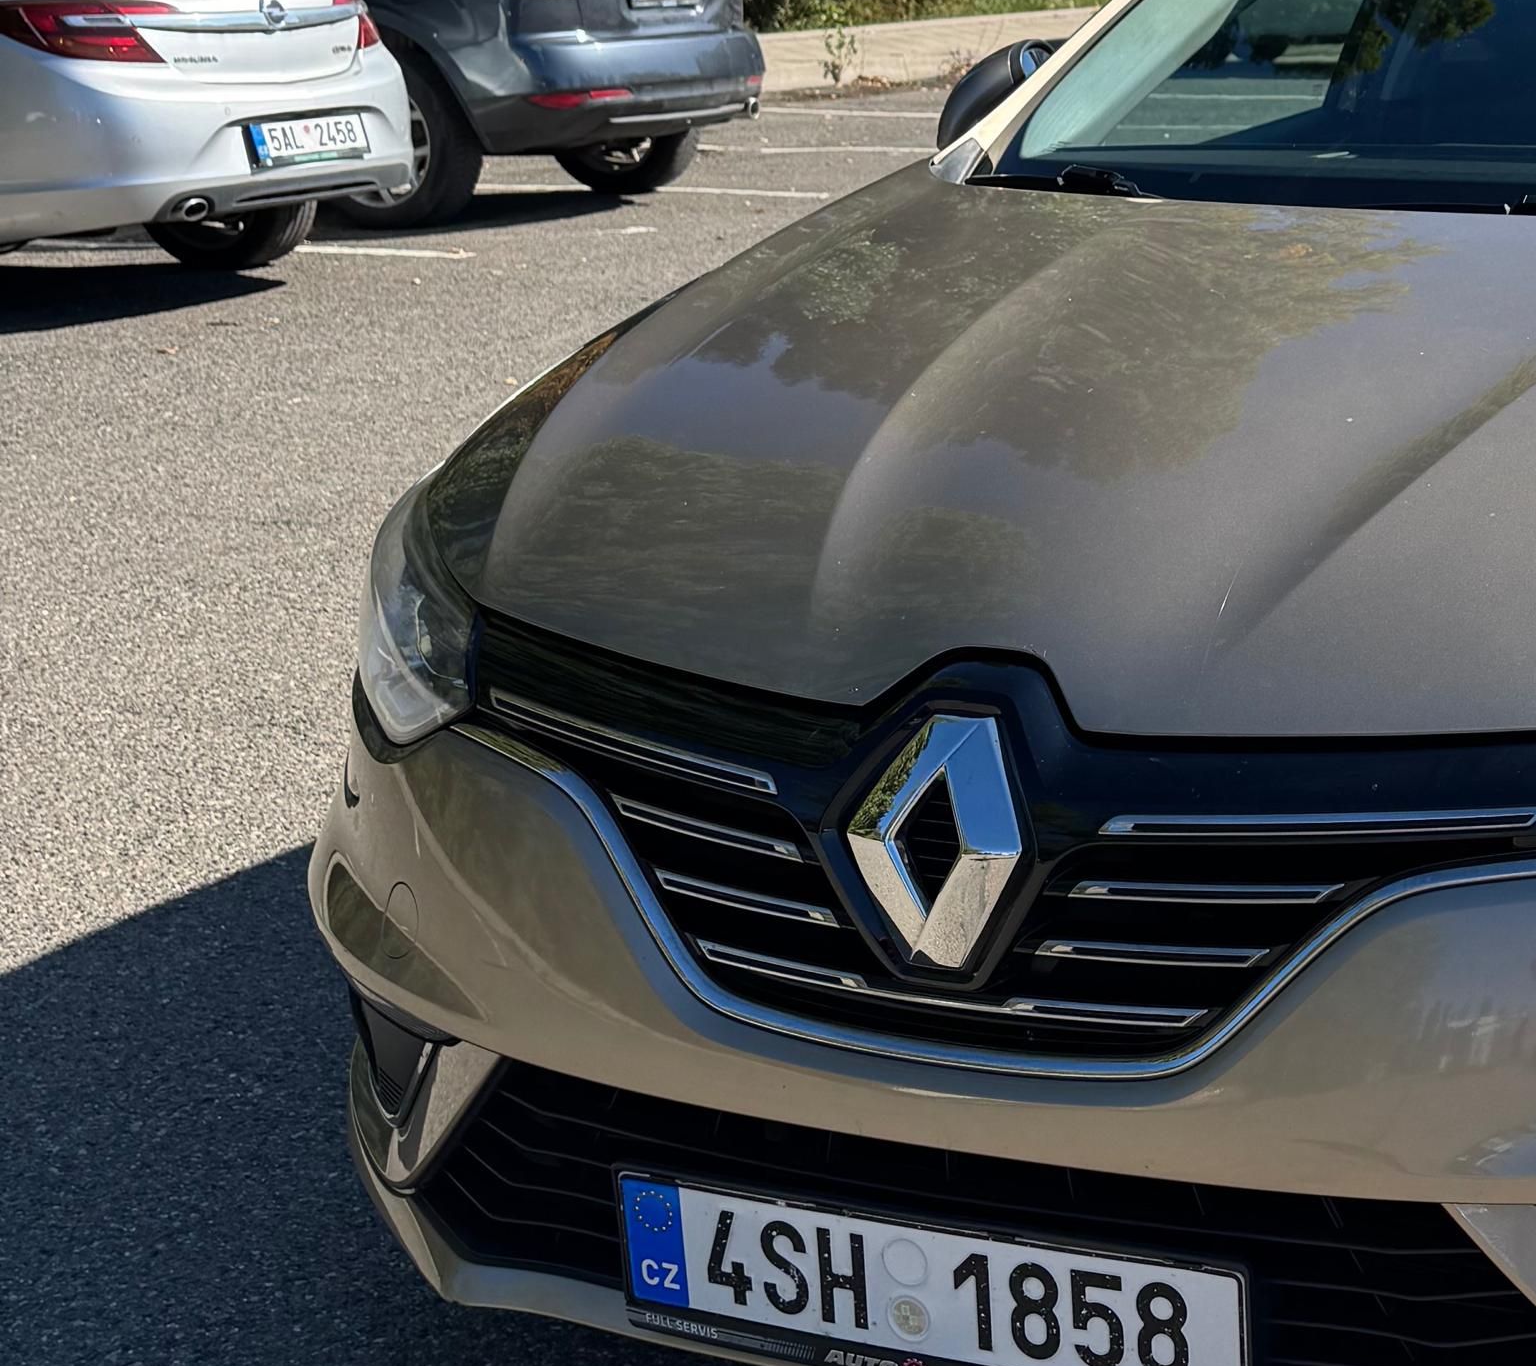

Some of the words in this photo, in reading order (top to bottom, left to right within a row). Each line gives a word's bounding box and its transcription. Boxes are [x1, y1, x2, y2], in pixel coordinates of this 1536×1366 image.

[268, 125, 304, 151] 5AL
[314, 120, 357, 147] 2458
[641, 1258, 681, 1290] CZ
[707, 1209, 869, 1330] 4SH
[645, 1312, 672, 1330] FULL
[676, 1320, 719, 1339] SERVIS
